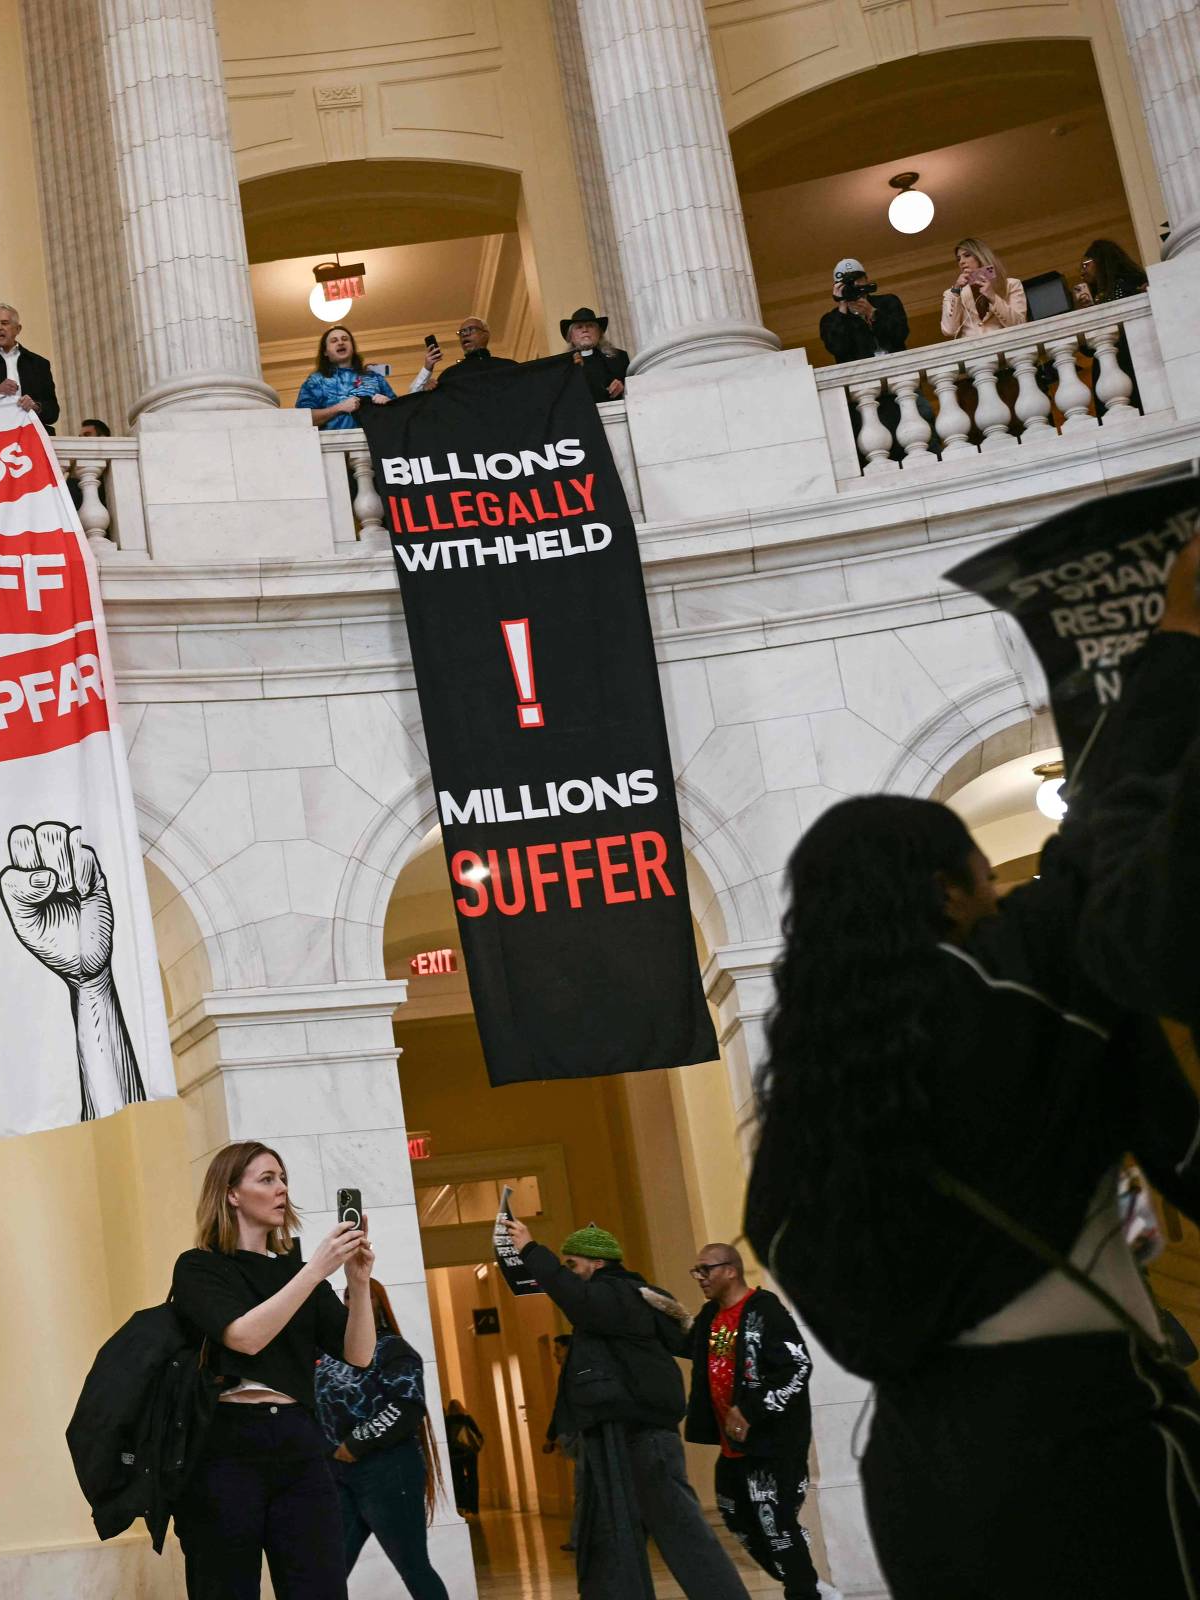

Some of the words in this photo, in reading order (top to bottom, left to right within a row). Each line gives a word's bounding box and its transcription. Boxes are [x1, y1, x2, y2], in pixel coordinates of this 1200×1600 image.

[327, 277, 359, 300] EXIT
[381, 438, 586, 486] BILLIONS
[387, 473, 597, 534] ILLEGALLY
[394, 522, 613, 572] WITHHELD
[1051, 593, 1165, 637] RESTO
[500, 617, 545, 728] !
[1076, 630, 1150, 671] PEPF
[438, 769, 659, 825] MILLIONS
[451, 829, 676, 918] SUFFER
[417, 949, 452, 974] EXIT
[408, 1139, 425, 1159] XIT
